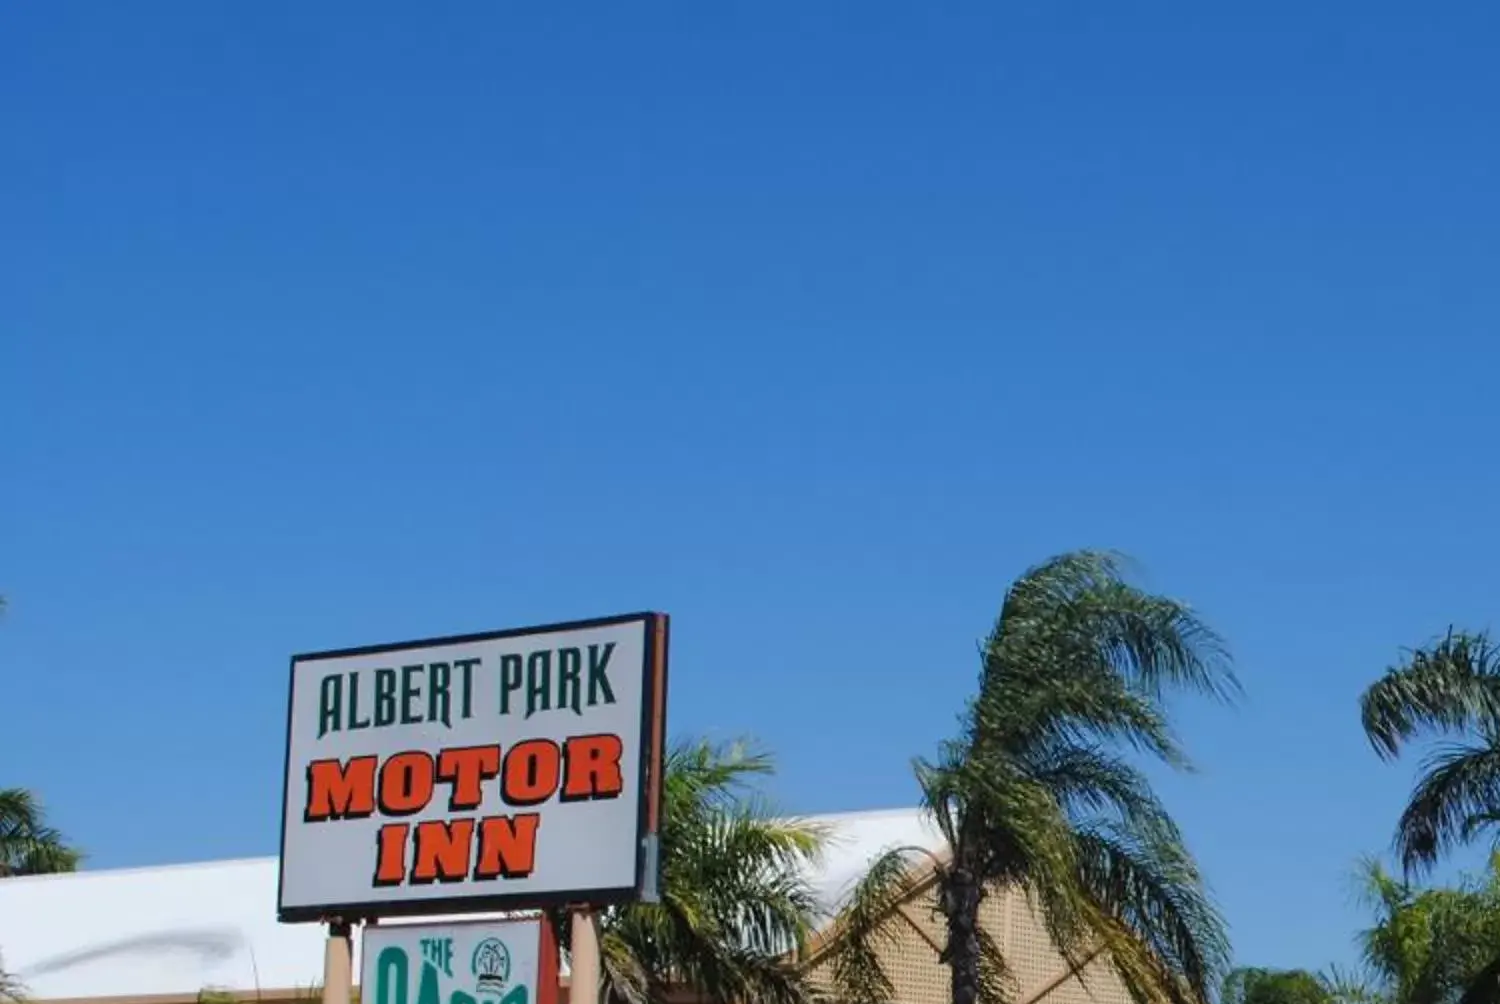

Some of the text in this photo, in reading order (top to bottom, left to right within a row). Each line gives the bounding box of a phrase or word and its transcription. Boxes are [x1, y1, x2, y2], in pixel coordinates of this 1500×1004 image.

[317, 642, 616, 739] ALBERT PARK
[304, 734, 622, 822] MOTOR
[373, 813, 540, 887] INN
[420, 938, 453, 977] THE
